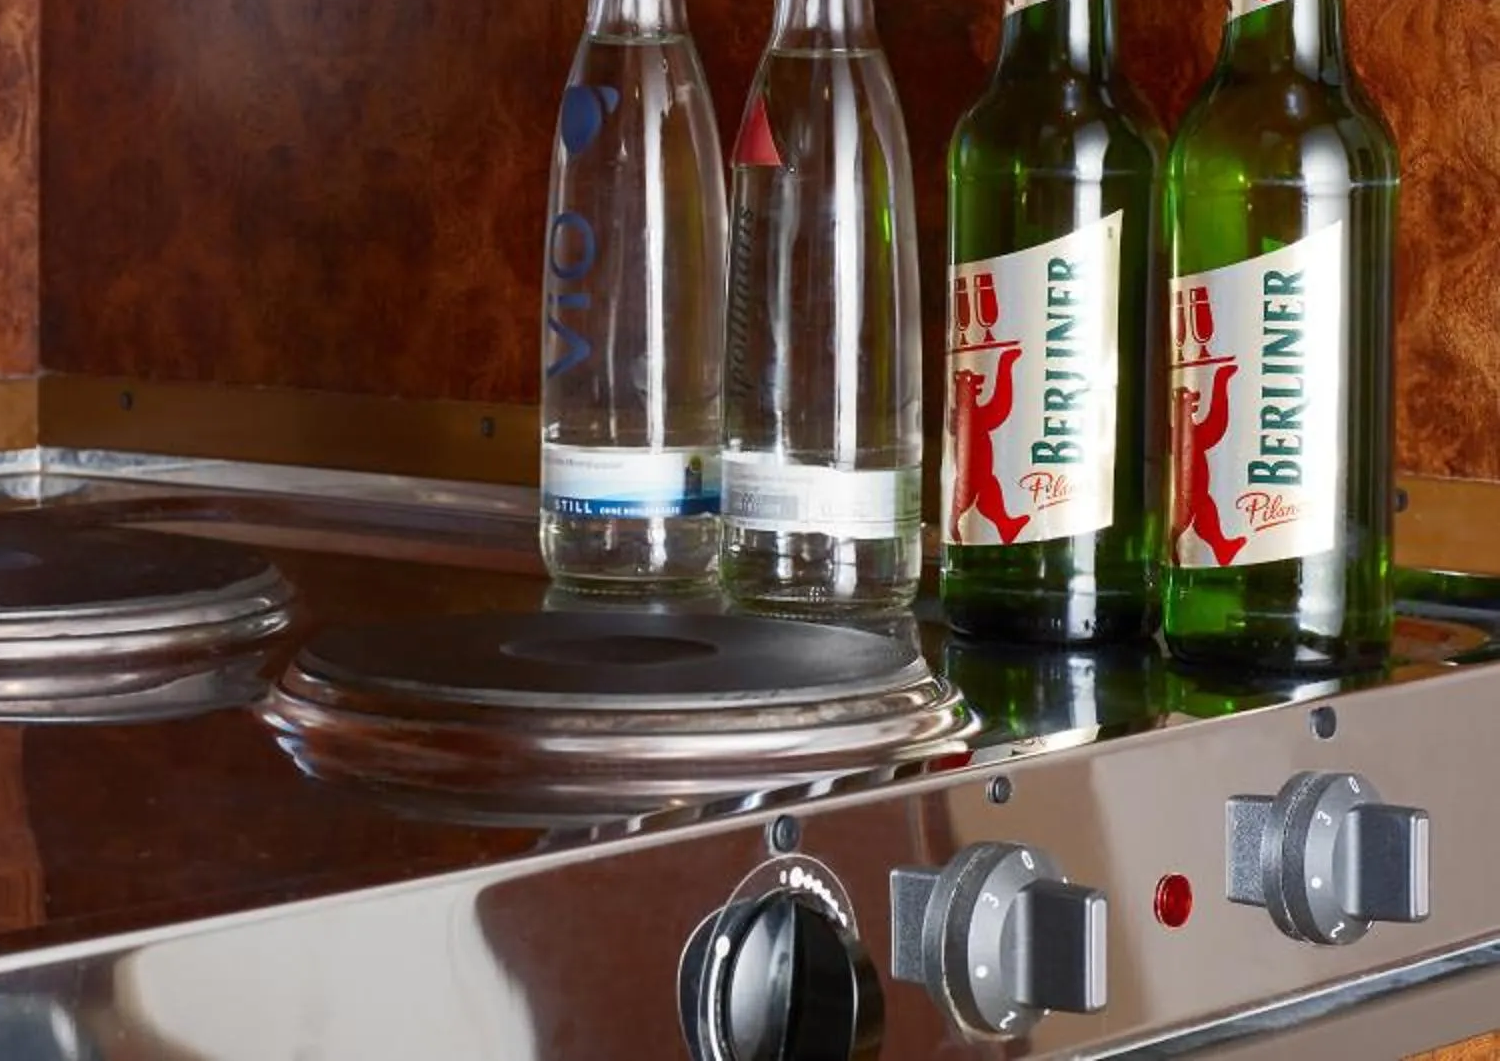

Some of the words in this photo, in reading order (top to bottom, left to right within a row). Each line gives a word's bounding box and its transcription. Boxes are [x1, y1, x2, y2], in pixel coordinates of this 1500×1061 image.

[1031, 256, 1090, 466] BERLINER
[1247, 268, 1311, 486] BERLINER
[555, 499, 592, 515] STILL
[1317, 810, 1332, 827] 3
[982, 892, 1000, 908] 3
